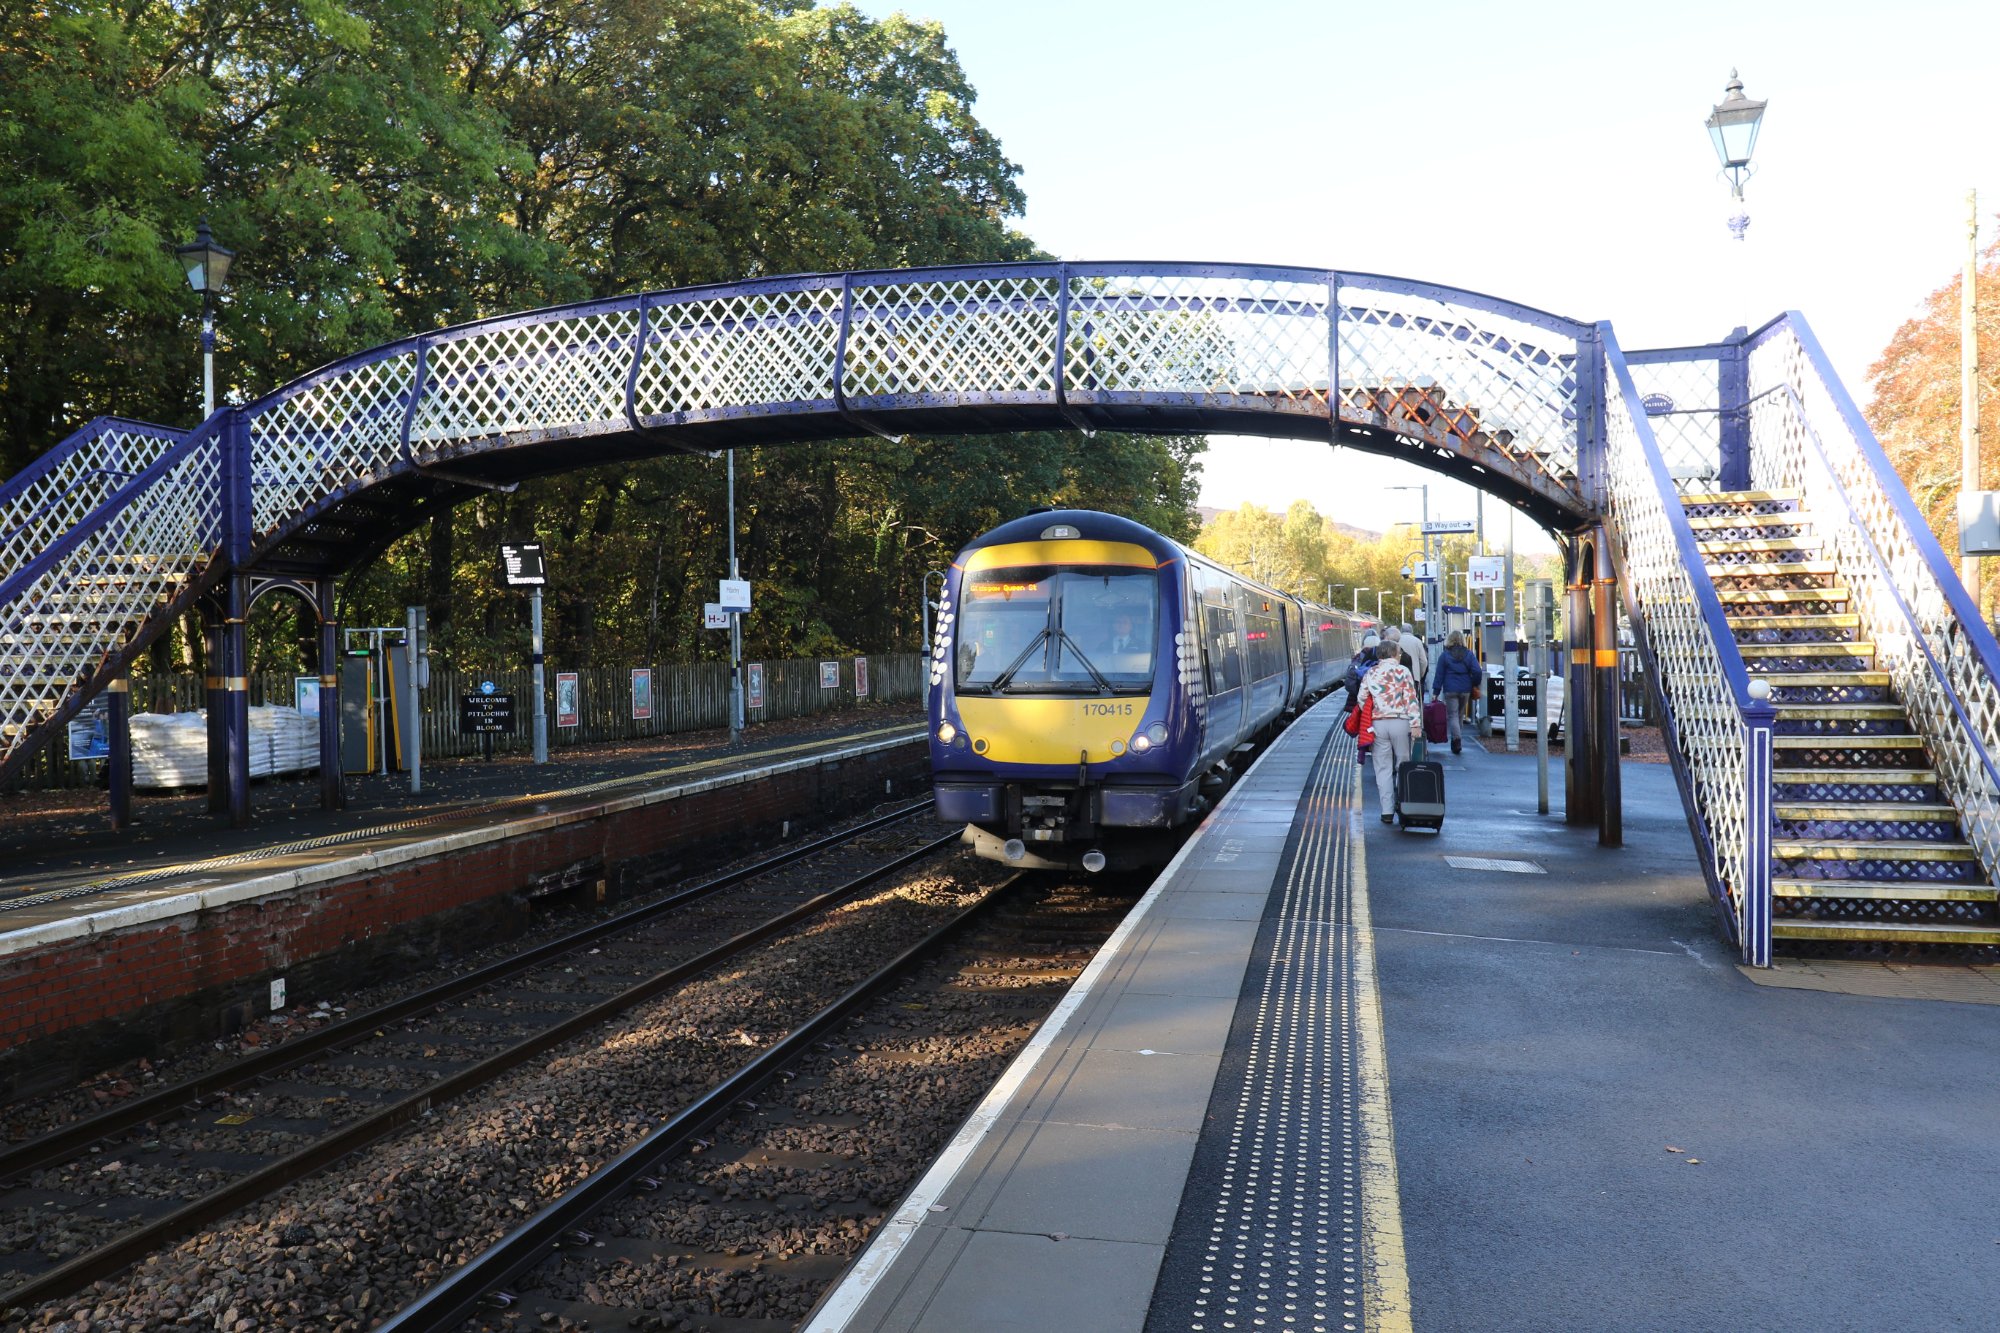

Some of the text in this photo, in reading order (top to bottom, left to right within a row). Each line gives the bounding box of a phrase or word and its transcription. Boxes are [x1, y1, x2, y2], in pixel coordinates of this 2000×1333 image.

[1421, 563, 1430, 576] 1
[1473, 571, 1499, 581] H-J
[708, 614, 727, 623] H-J
[1082, 703, 1133, 716] 170415
